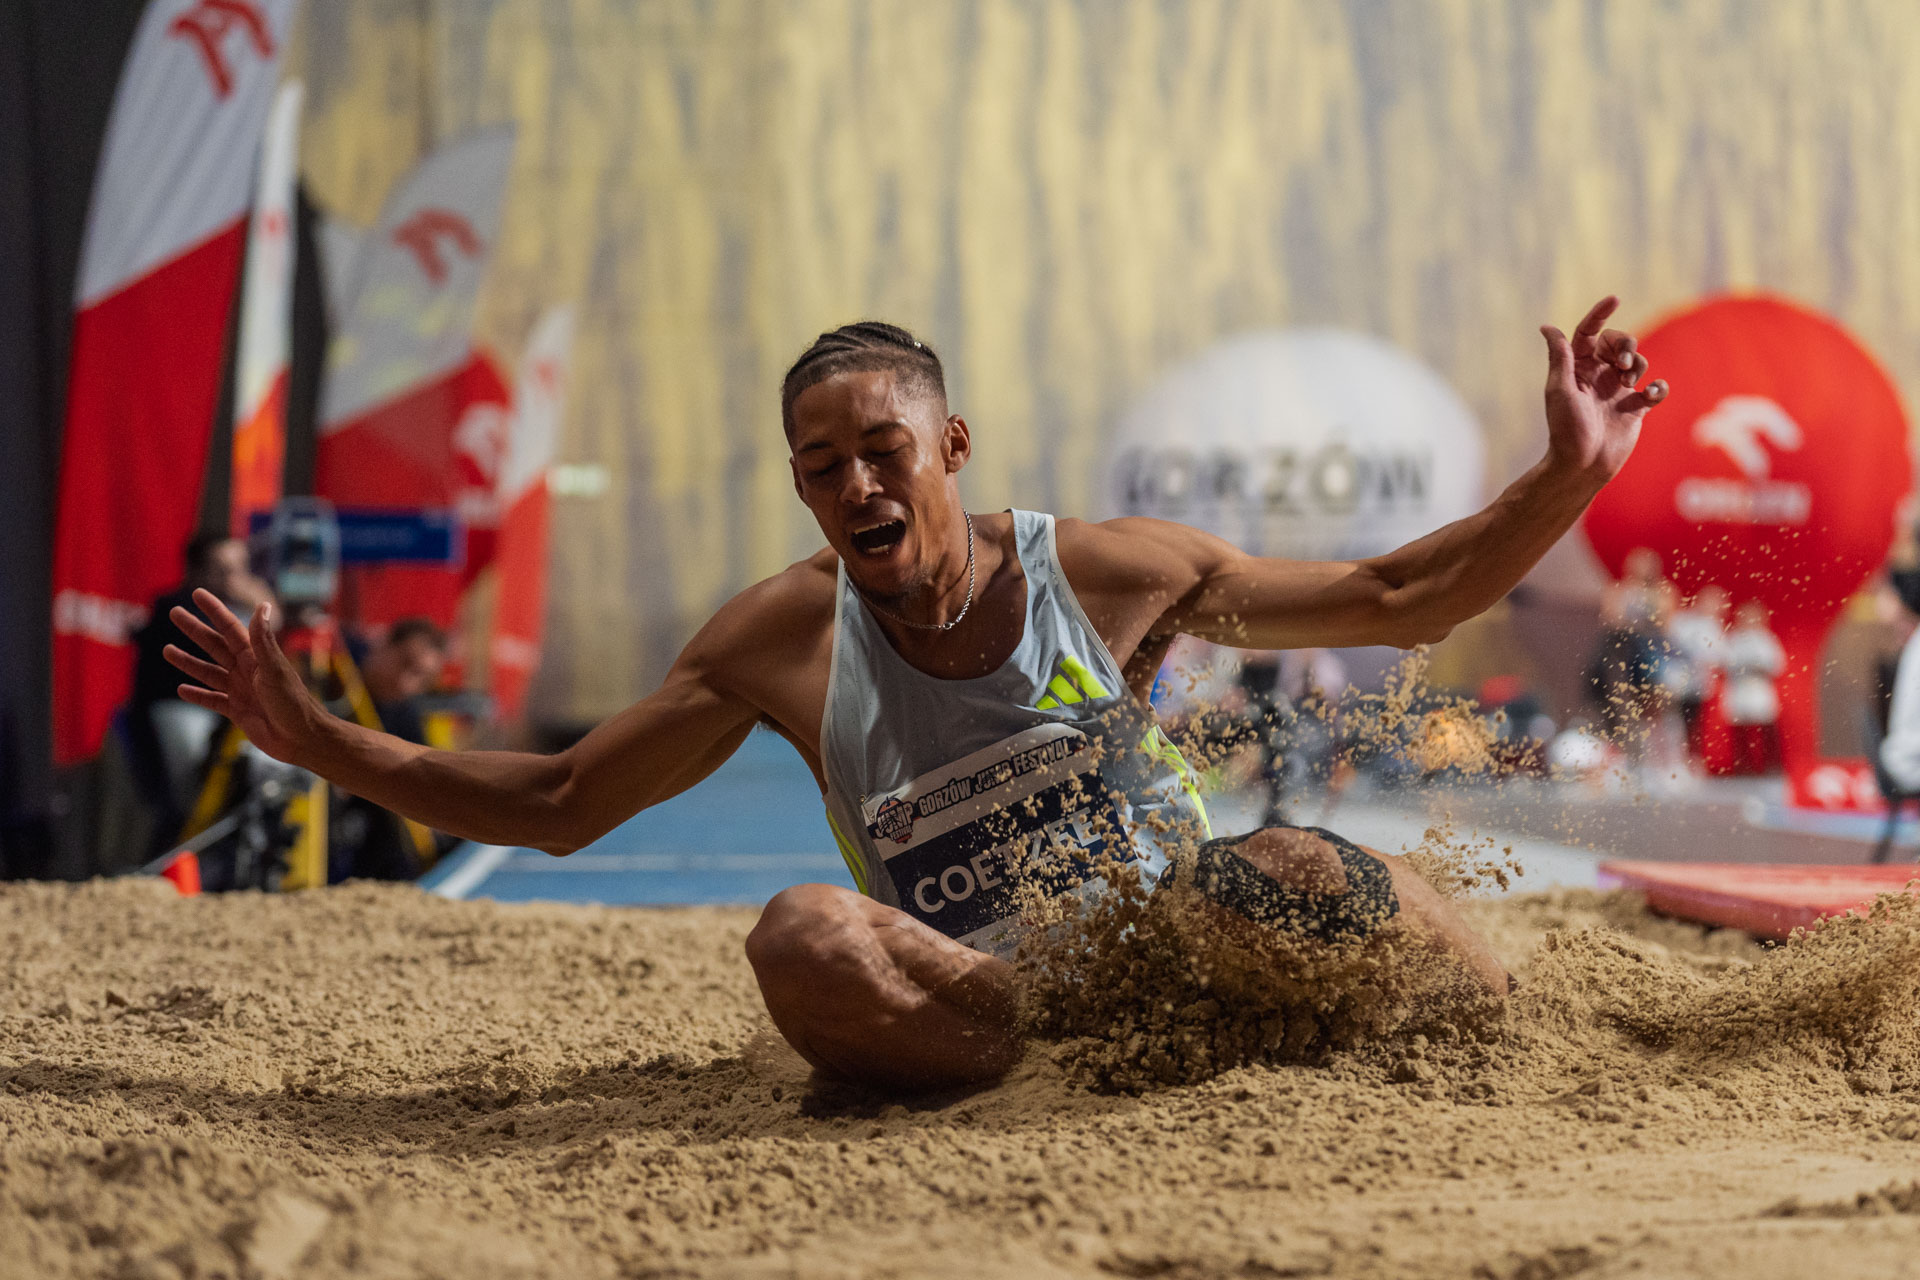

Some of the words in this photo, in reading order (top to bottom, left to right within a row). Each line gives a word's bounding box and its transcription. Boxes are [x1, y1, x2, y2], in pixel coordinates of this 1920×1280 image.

[918, 777, 972, 817] GORZÓW
[1012, 736, 1073, 776] FESTIVAL
[914, 807, 1102, 914] COETZEE
